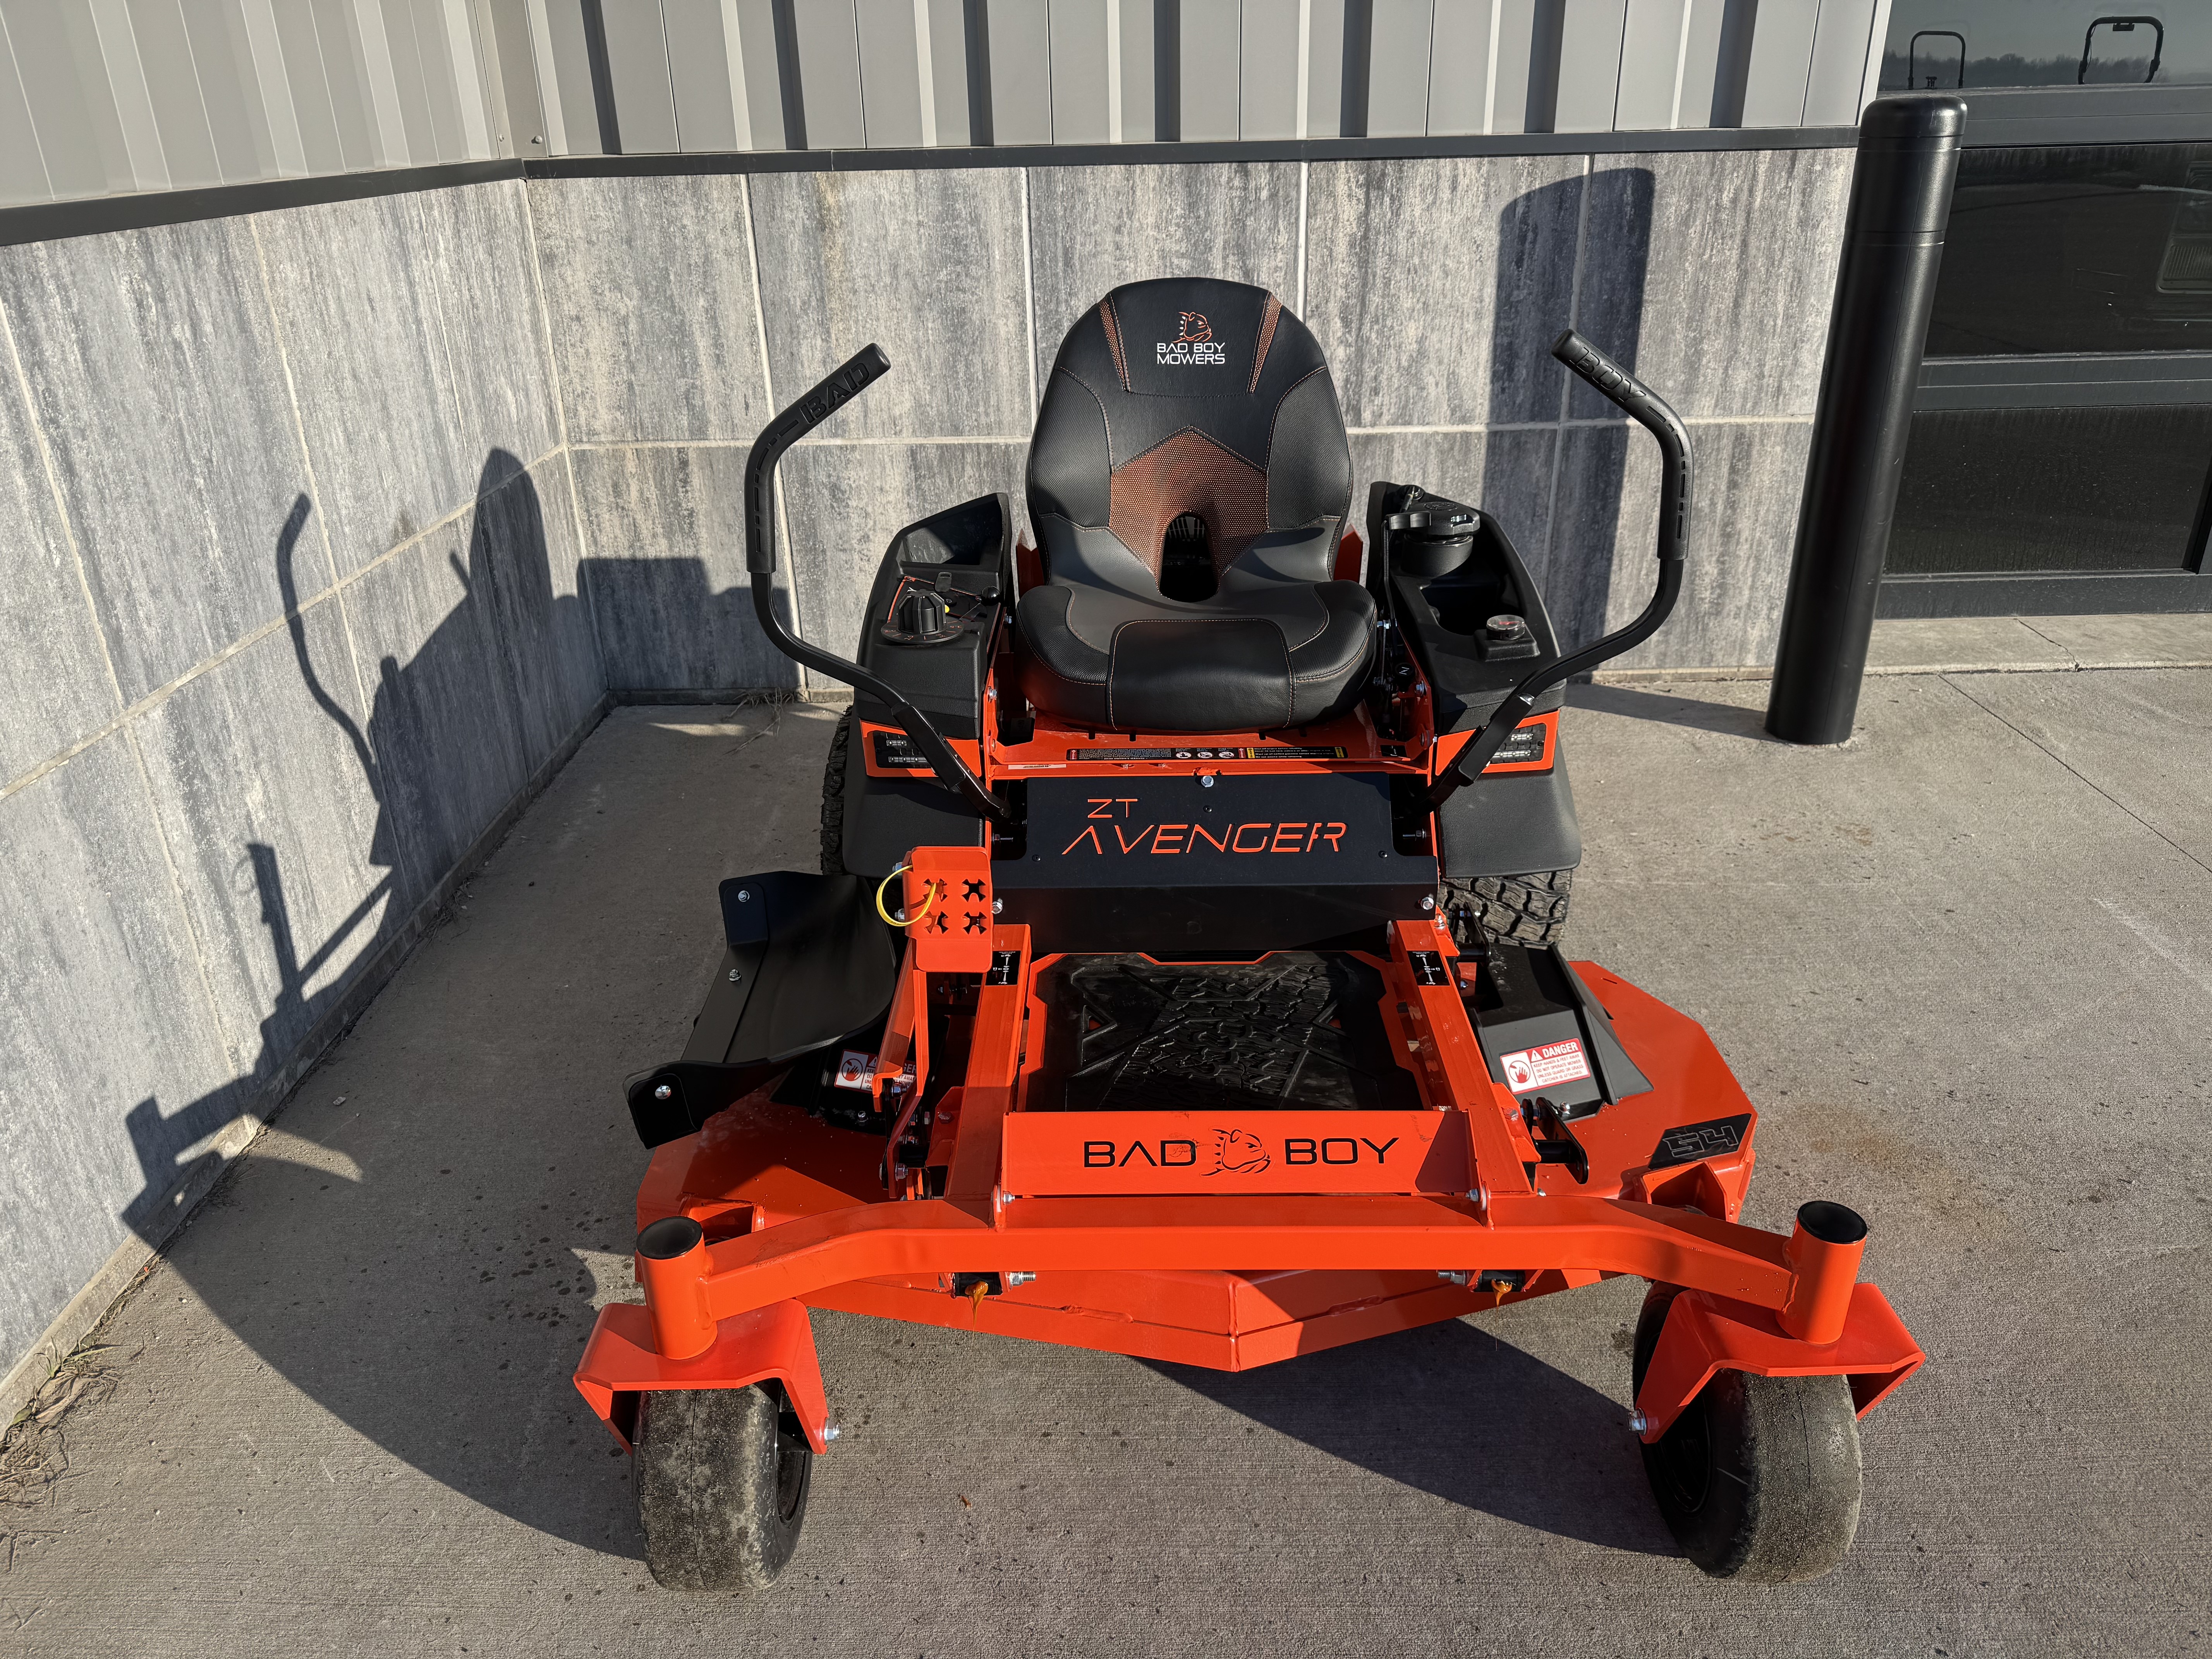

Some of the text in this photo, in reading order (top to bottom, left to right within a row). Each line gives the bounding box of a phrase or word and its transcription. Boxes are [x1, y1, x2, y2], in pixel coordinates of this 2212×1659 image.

[1157, 342, 1225, 353] BAD BOY
[1157, 353, 1225, 365] MOWERS
[1569, 347, 1646, 402] BOY
[800, 363, 869, 424] BAD
[1087, 799, 1138, 818] ZT
[1061, 823, 1347, 854] AVENGER
[1542, 1042, 1578, 1058] DANGER
[1084, 1137, 1400, 1167] BAD BOY
[1662, 1125, 1739, 1158] 54
